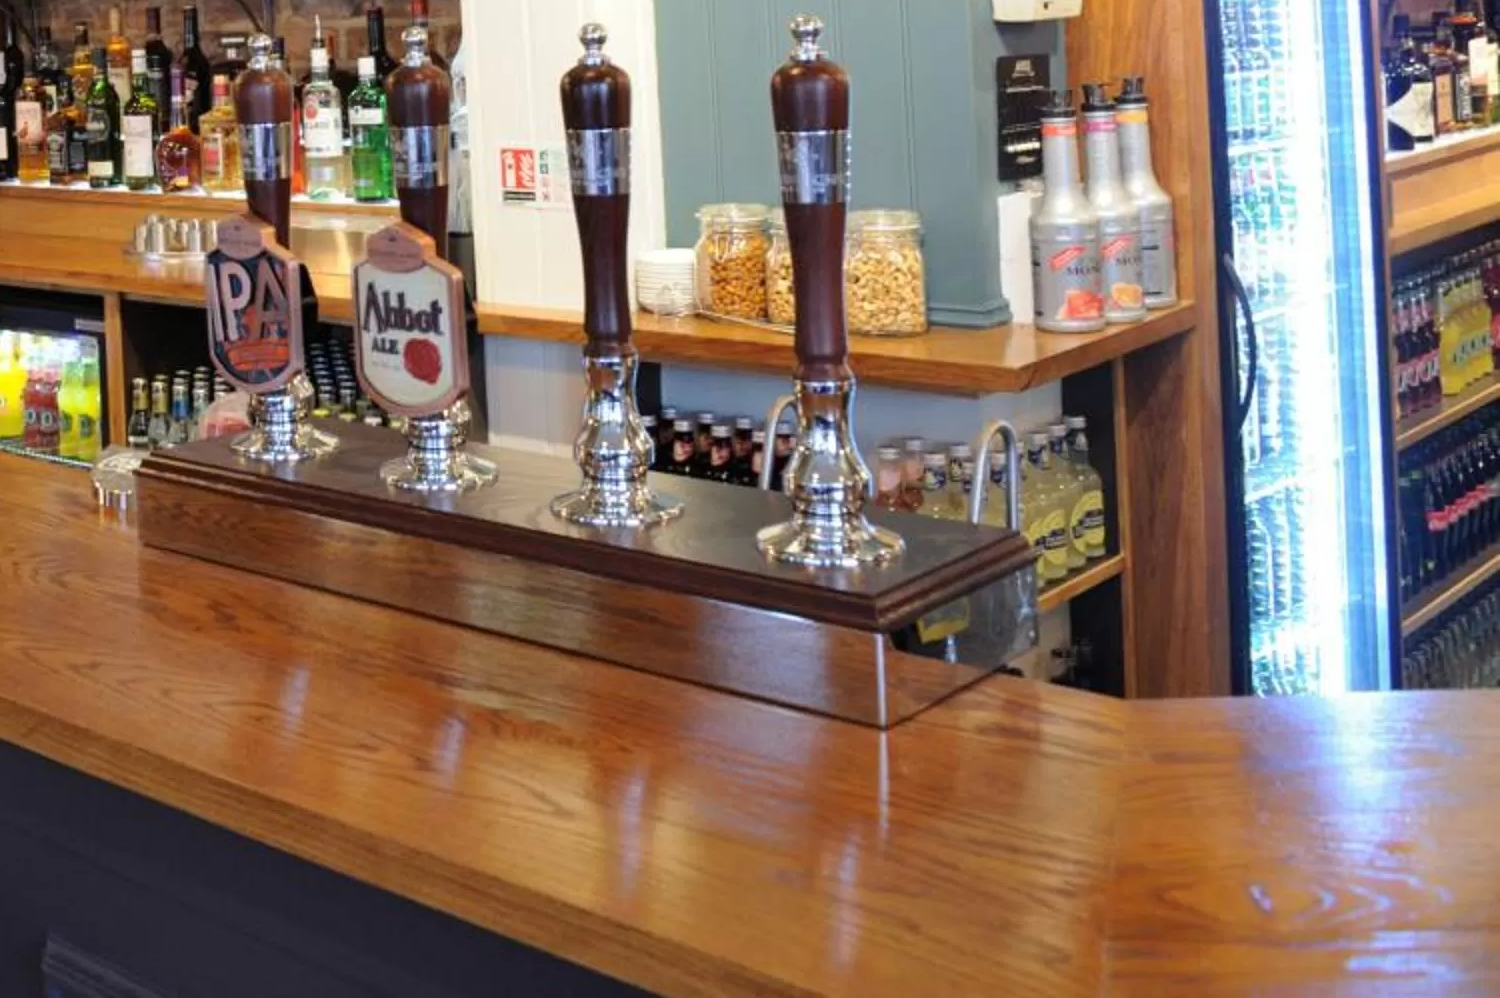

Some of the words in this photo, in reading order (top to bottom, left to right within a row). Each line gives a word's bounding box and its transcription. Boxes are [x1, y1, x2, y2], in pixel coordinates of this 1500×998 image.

[205, 260, 287, 342] IPA
[363, 281, 445, 336] Abbot
[372, 337, 400, 354] ALE
